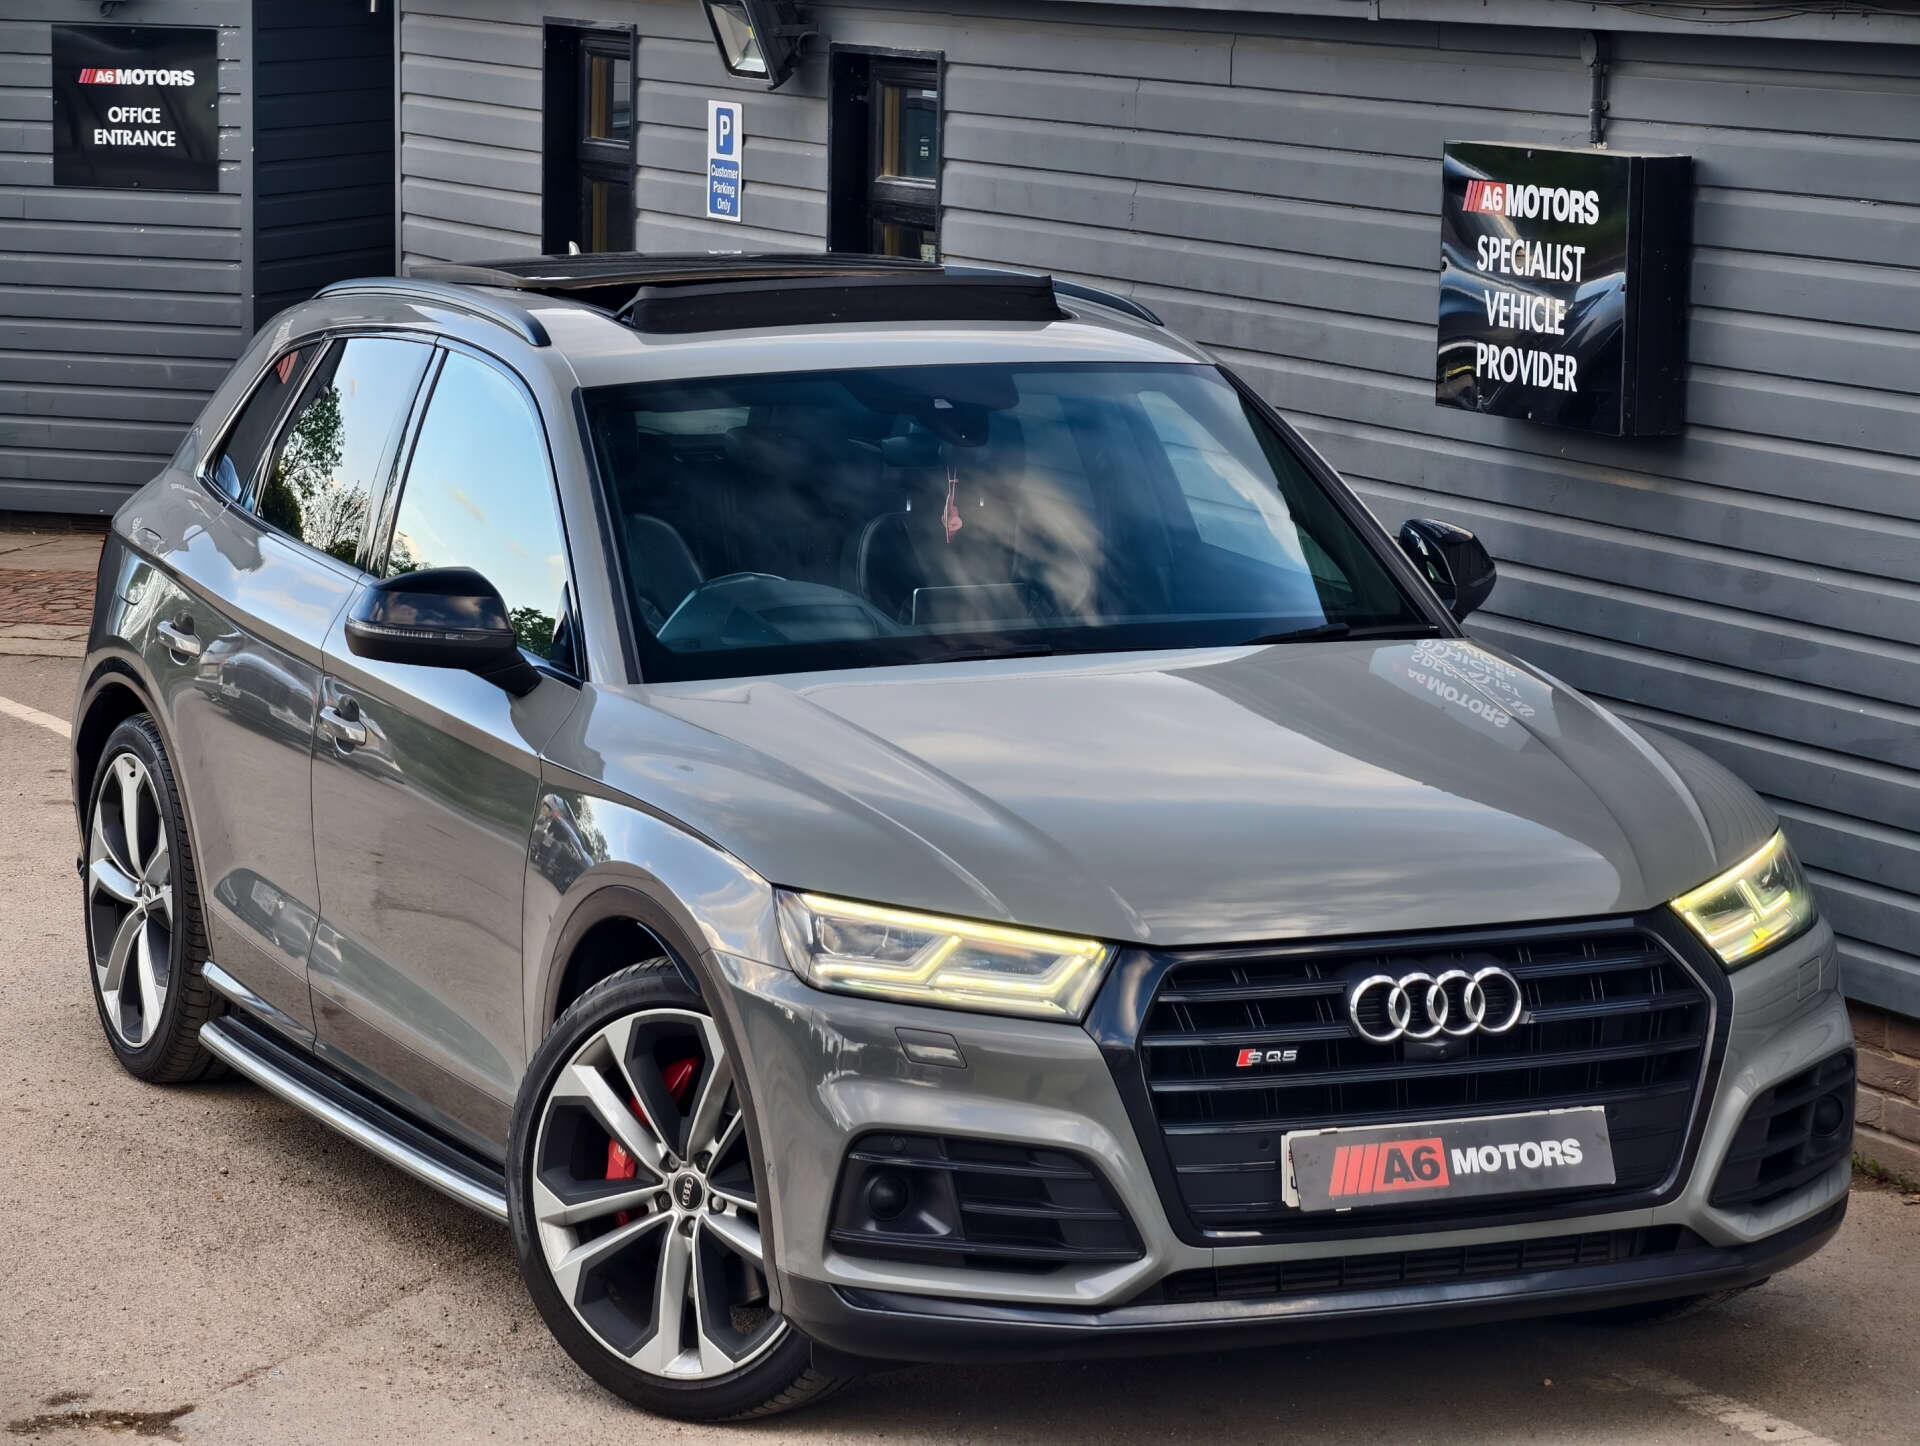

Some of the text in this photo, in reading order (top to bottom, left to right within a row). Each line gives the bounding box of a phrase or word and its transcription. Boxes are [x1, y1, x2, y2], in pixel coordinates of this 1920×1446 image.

[107, 106, 161, 124] OFFICE
[93, 129, 176, 147] ENTRANCE
[719, 115, 731, 146] P
[710, 164, 739, 180] Customer
[713, 181, 736, 198] Parking
[717, 198, 731, 213] Only
[1476, 234, 1586, 283] SPECIALIST
[1484, 289, 1566, 336] VEHICLE
[1476, 342, 1578, 393] PROVIDER
[1382, 1138, 1583, 1185] A6 MOTORS
